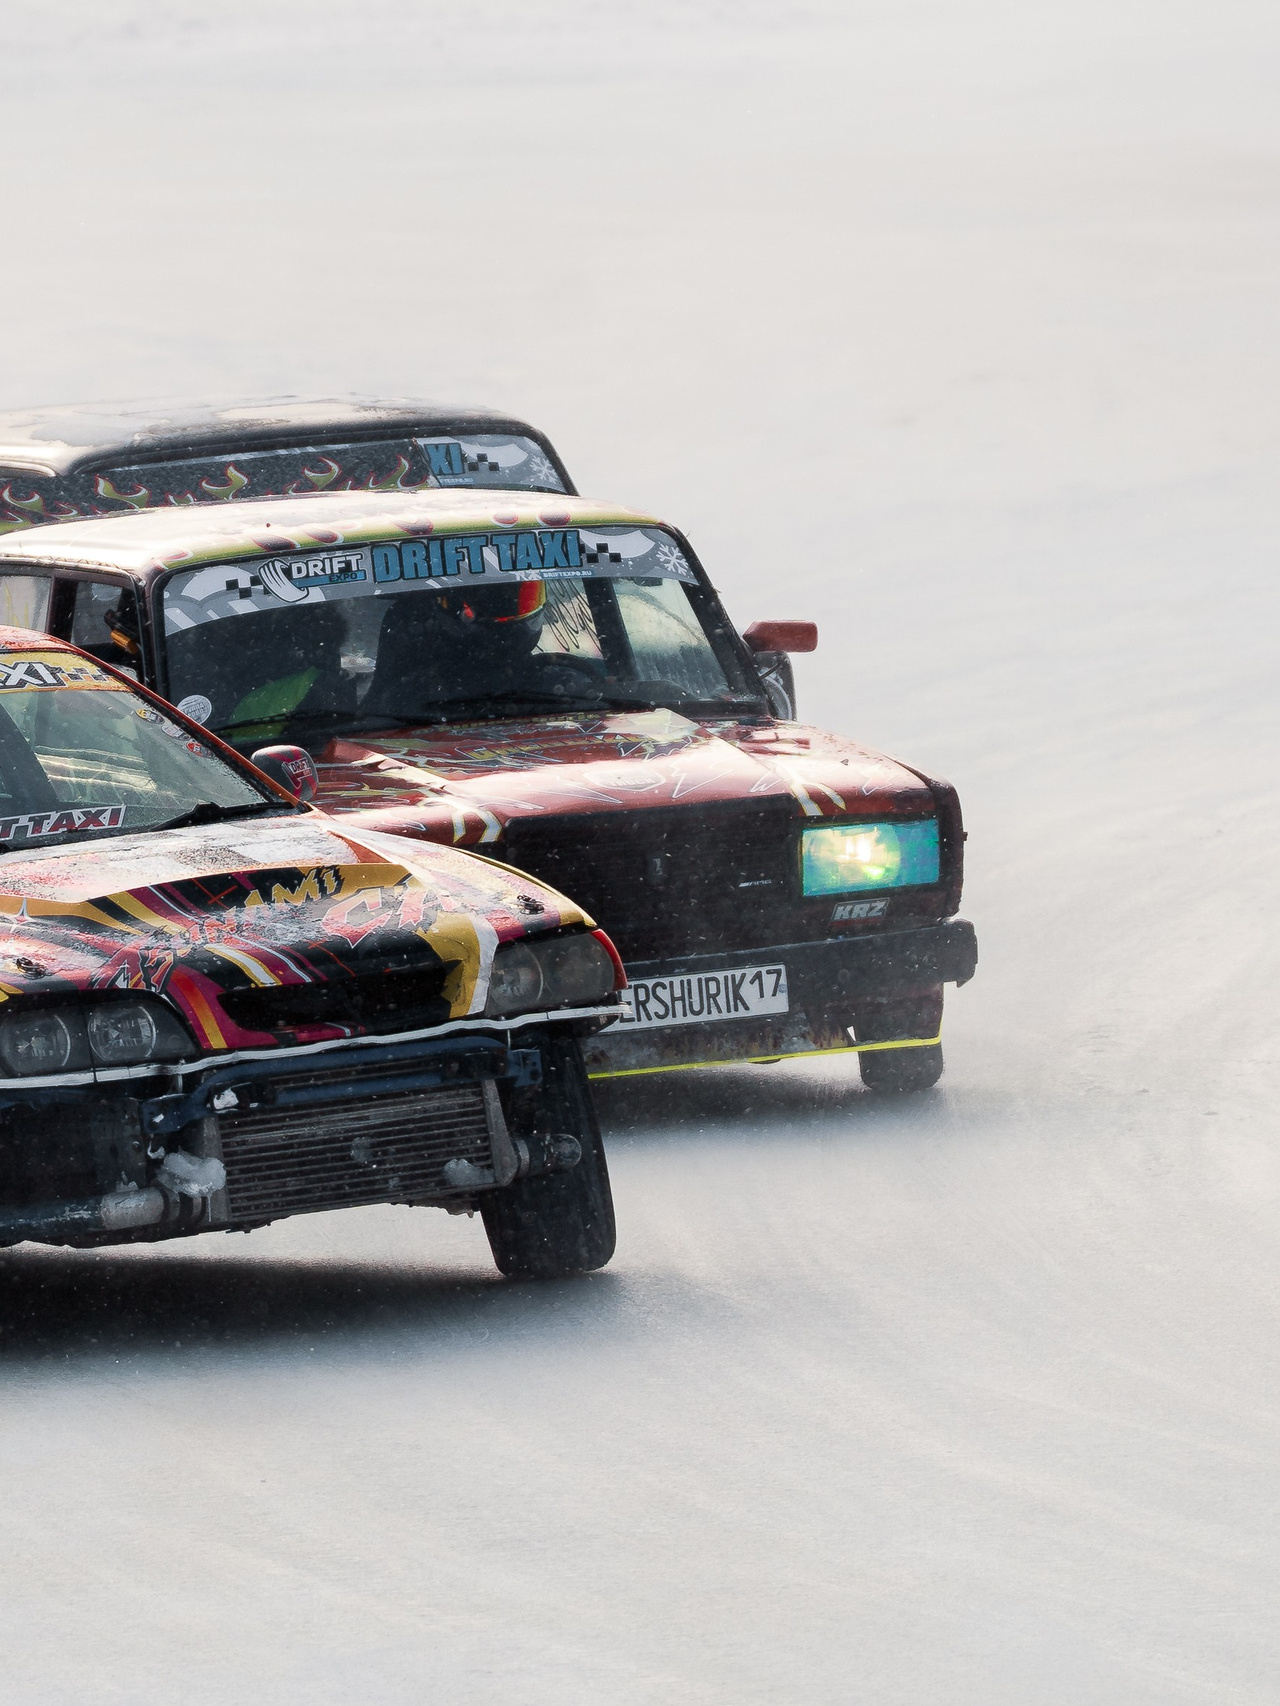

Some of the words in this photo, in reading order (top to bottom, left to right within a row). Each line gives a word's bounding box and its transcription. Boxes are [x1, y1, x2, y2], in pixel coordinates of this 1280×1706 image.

[423, 442, 464, 475] XI
[291, 553, 362, 579] DRIFT
[372, 534, 488, 583] DRIFT
[491, 529, 583, 571] TAXI
[329, 572, 358, 582] EXPO
[28, 807, 122, 835] TAXI
[619, 968, 783, 1024] ERSHURIK17
